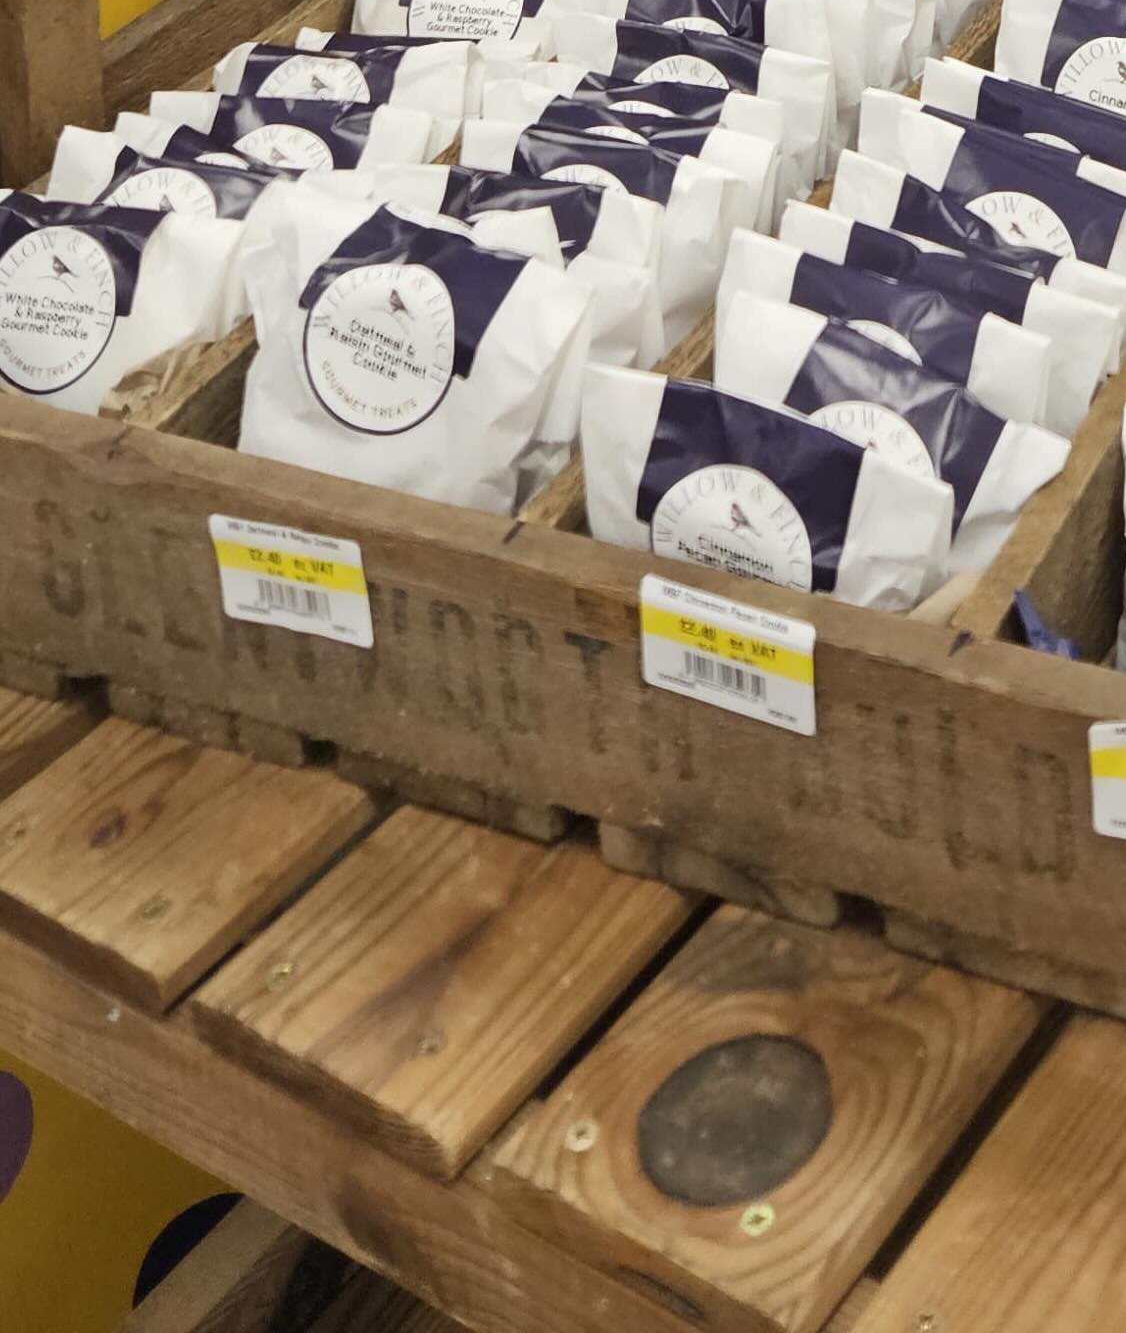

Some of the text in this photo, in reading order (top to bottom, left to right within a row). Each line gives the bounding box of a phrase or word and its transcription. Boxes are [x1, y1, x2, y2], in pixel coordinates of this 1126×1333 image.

[430, 2, 505, 18] White Chocolate
[427, 21, 498, 37] Gourmet Cookie
[446, 14, 493, 28] Raspberry
[6, 292, 95, 315] White Chocolate
[26, 307, 82, 327] Raspberry
[0, 317, 89, 340] Gourmet Cookie
